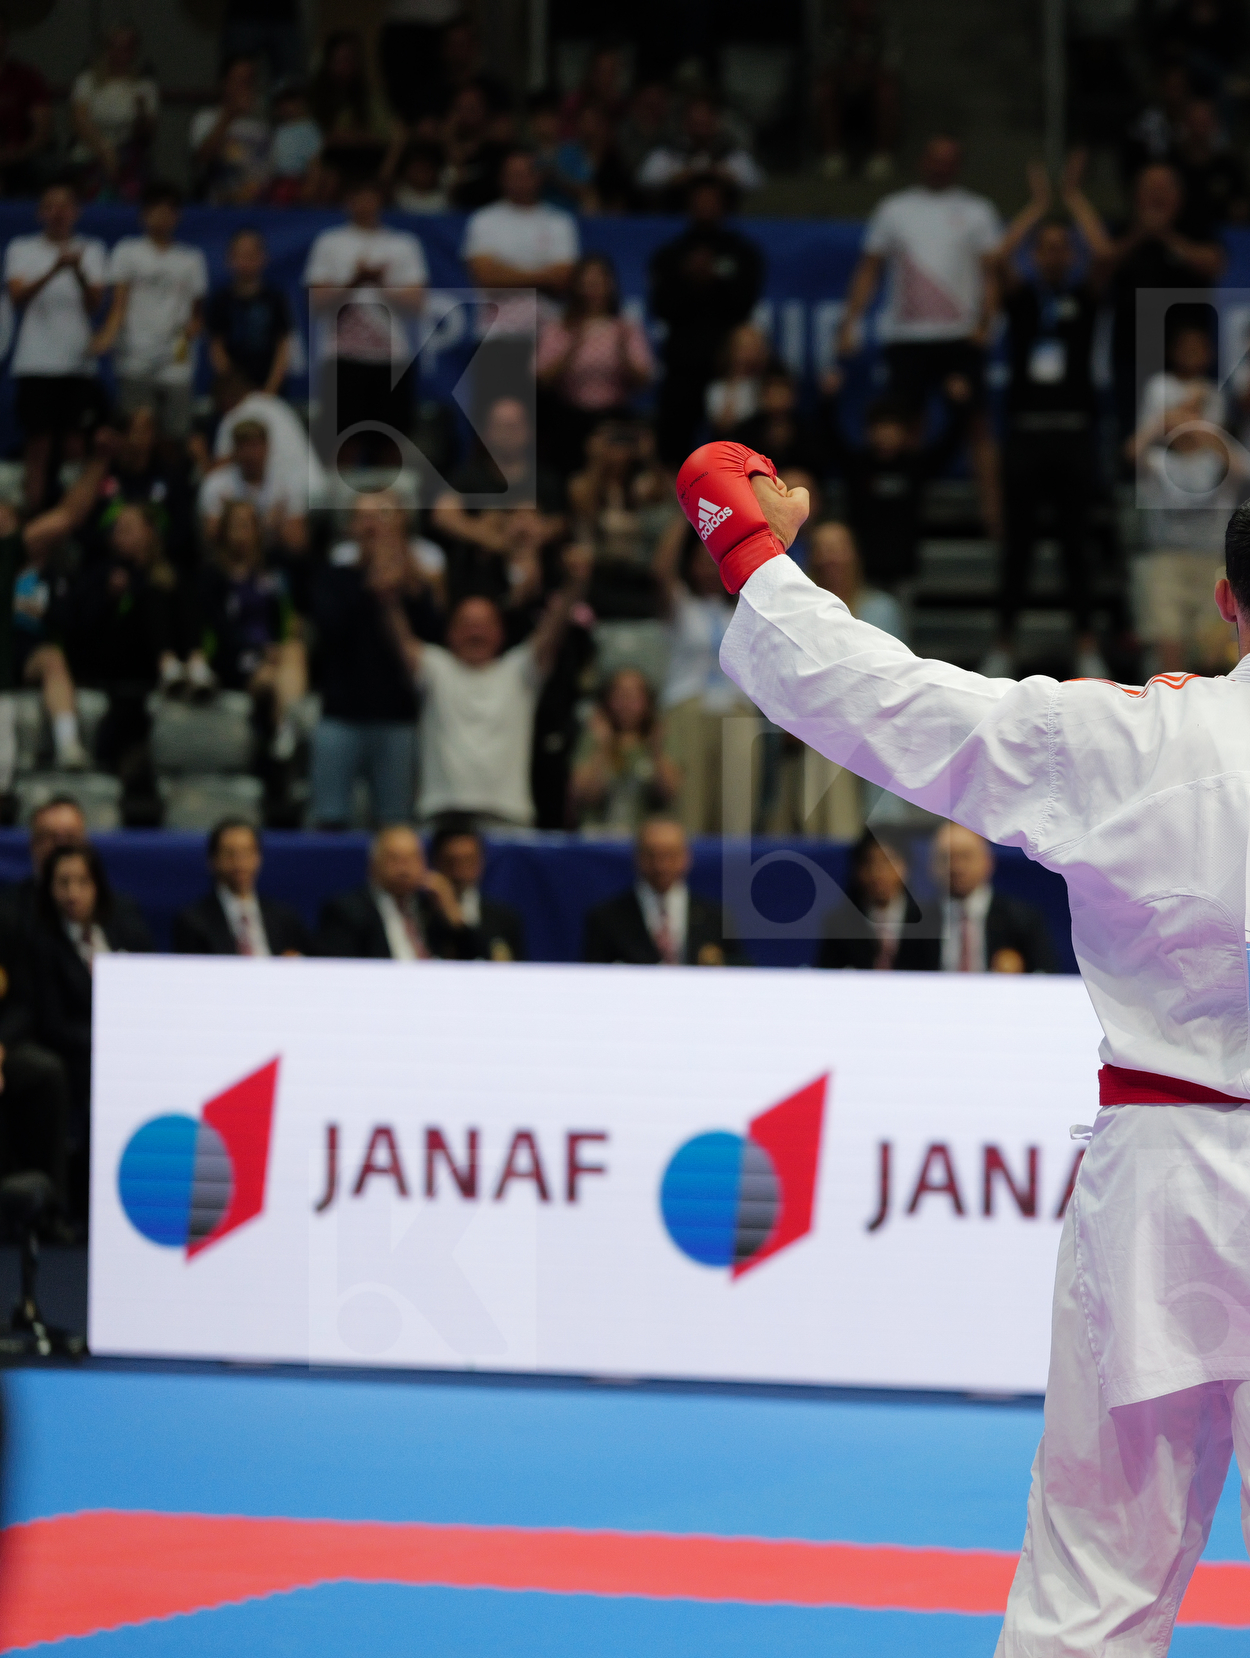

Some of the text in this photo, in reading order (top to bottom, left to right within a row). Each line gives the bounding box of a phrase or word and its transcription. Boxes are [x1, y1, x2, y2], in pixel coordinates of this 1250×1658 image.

[700, 506, 733, 541] adidas
[314, 1123, 608, 1213] JANAF
[865, 1140, 1087, 1232] JAN
